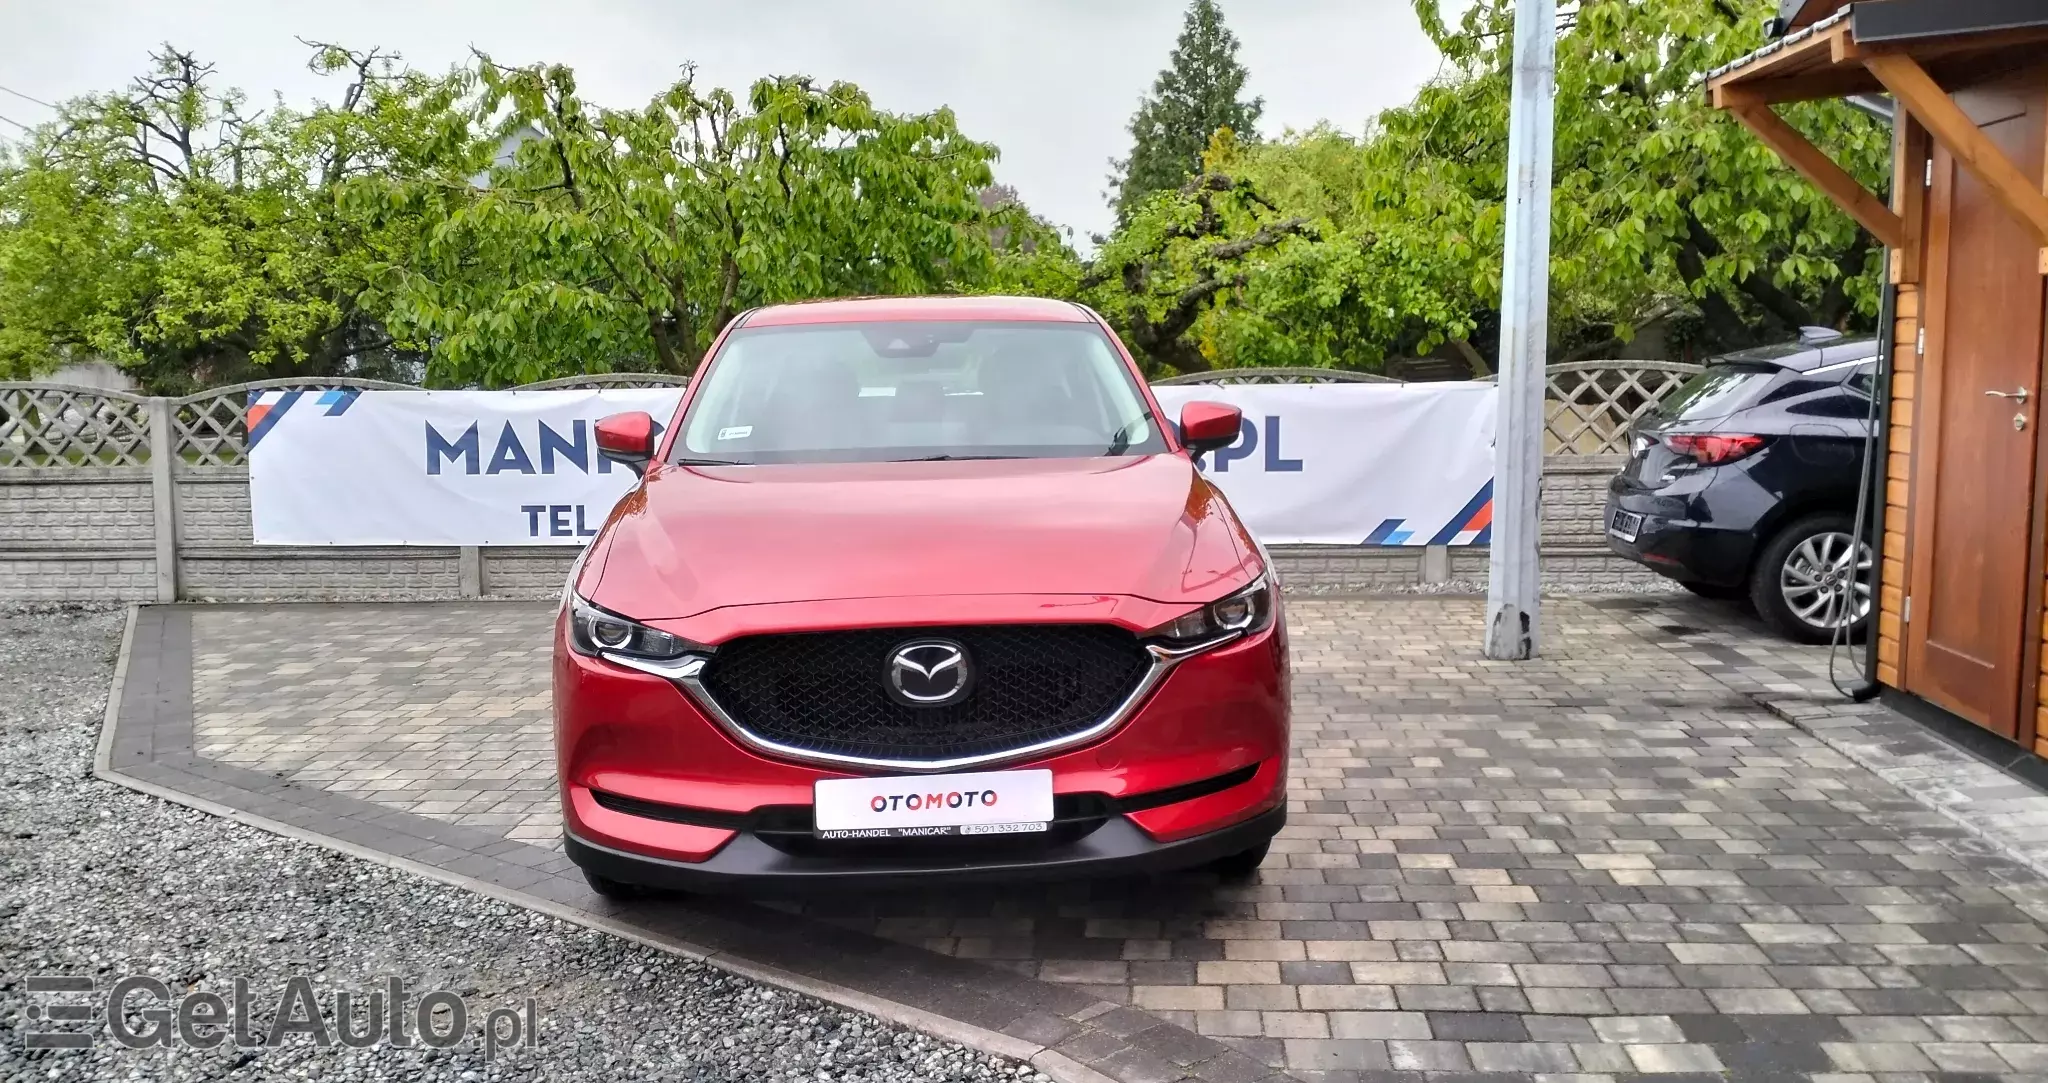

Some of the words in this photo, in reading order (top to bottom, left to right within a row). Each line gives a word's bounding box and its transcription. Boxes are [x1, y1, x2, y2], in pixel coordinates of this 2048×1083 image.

[1166, 415, 1304, 472] .PL
[870, 789, 998, 813] OTOMOTO
[822, 829, 891, 839] AUTO-HANDEL
[974, 825, 995, 833] 501
[998, 824, 1019, 832] 332
[1021, 822, 1043, 831] 703
